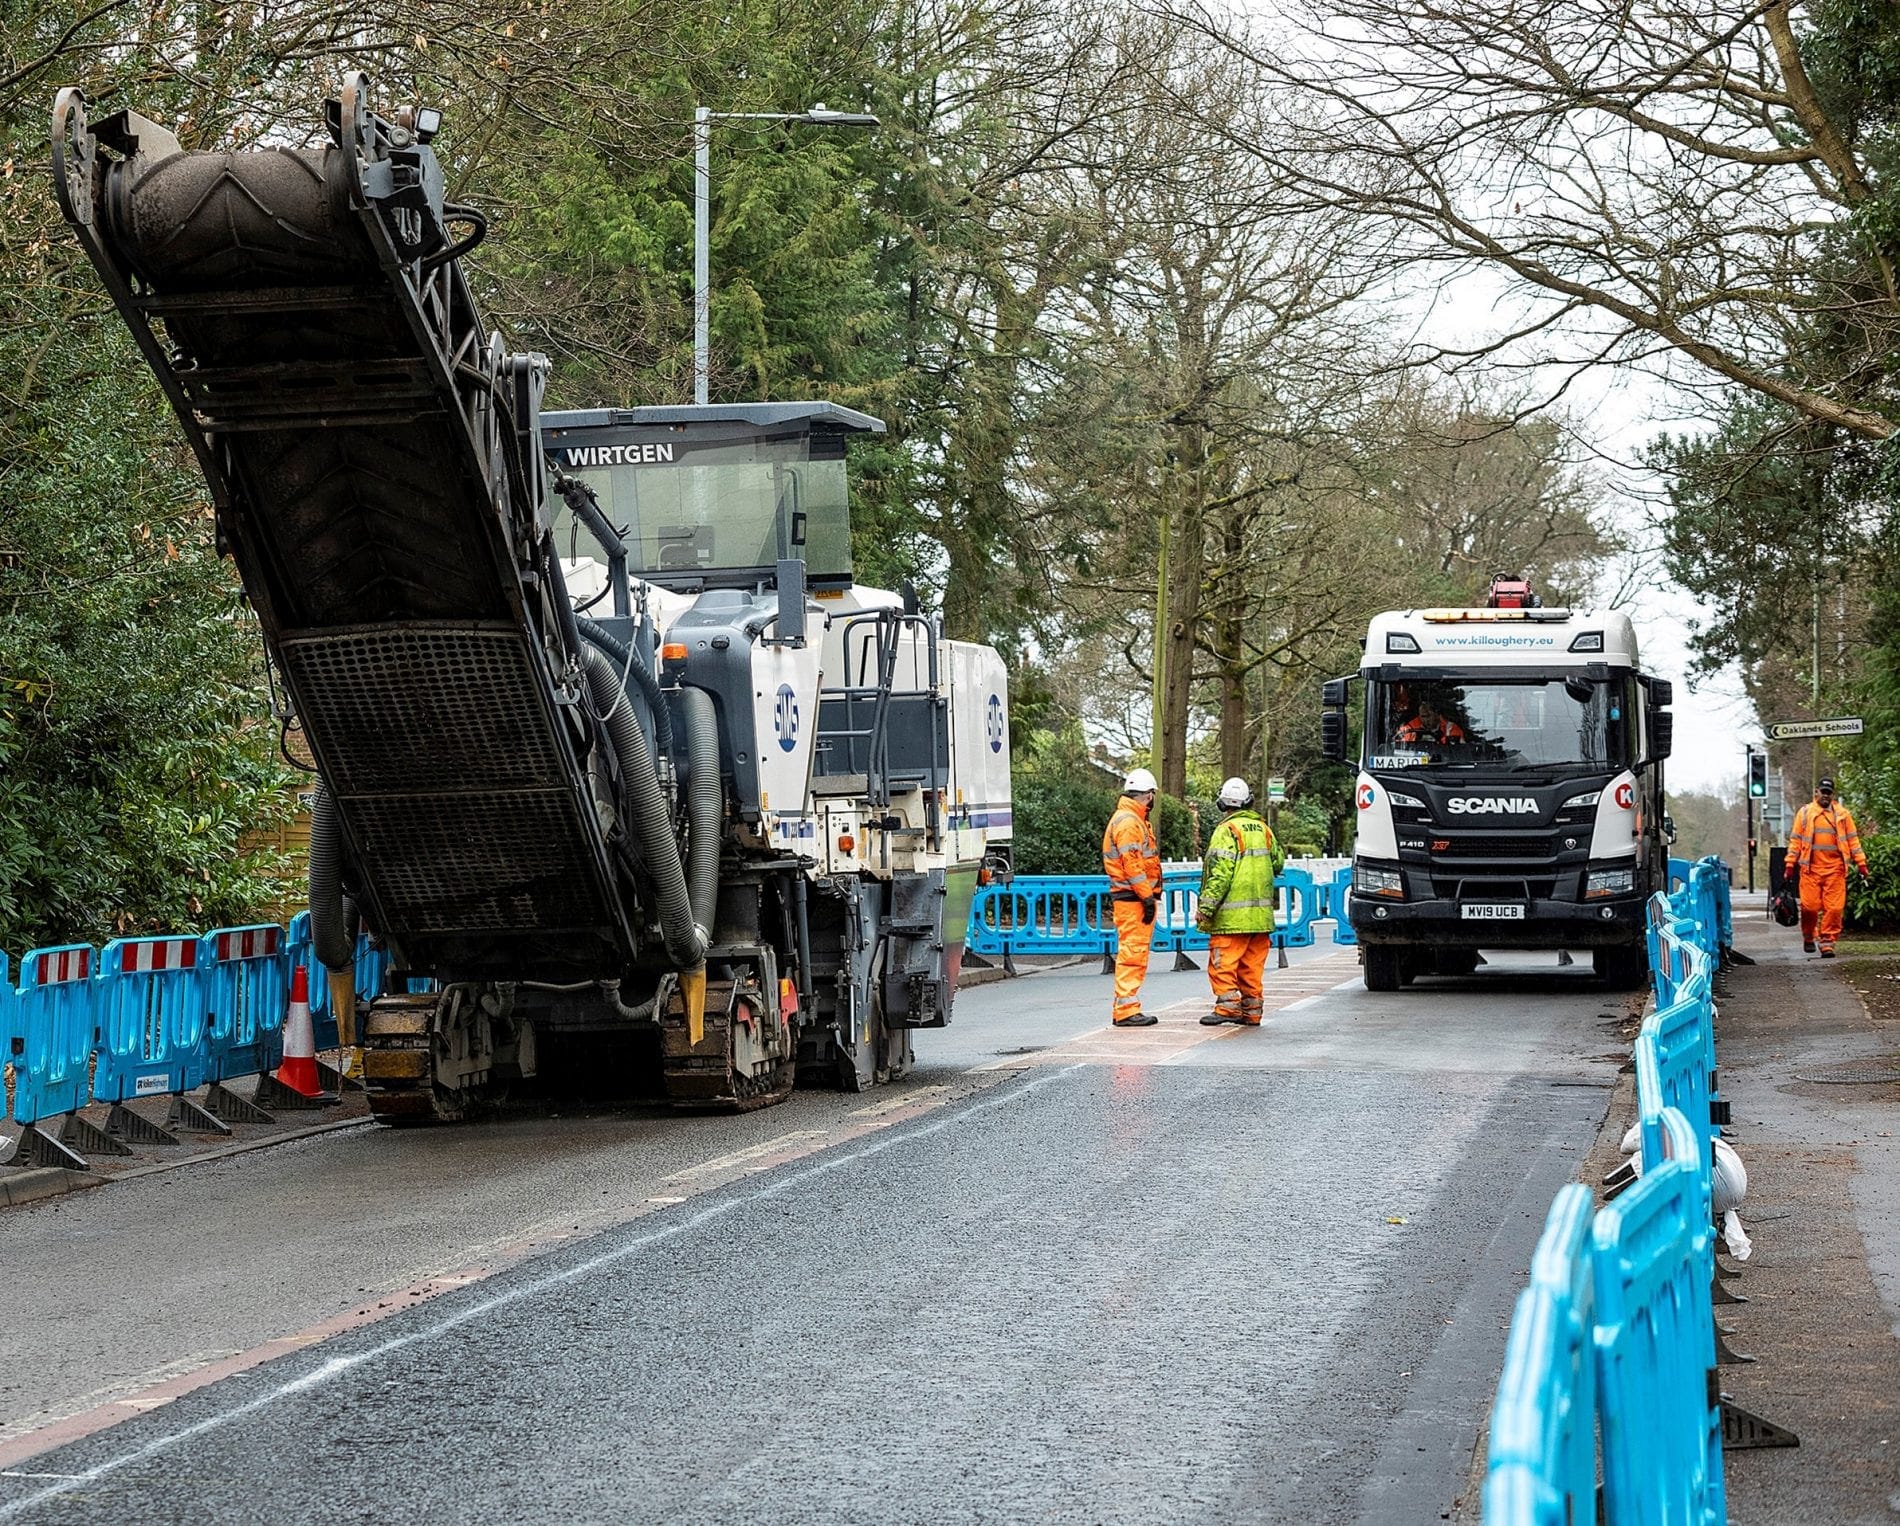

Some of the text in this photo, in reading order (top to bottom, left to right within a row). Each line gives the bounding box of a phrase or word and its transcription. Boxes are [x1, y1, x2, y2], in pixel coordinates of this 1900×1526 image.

[566, 443, 674, 466] WIRTGEN
[1435, 635, 1554, 647] www.killoughery.eu
[1781, 722, 1859, 735] Oaklands Schools
[1358, 787, 1373, 806] K
[1618, 787, 1633, 806] K
[1447, 797, 1540, 814] SCANIA
[1468, 906, 1518, 917] MV19 UCB
